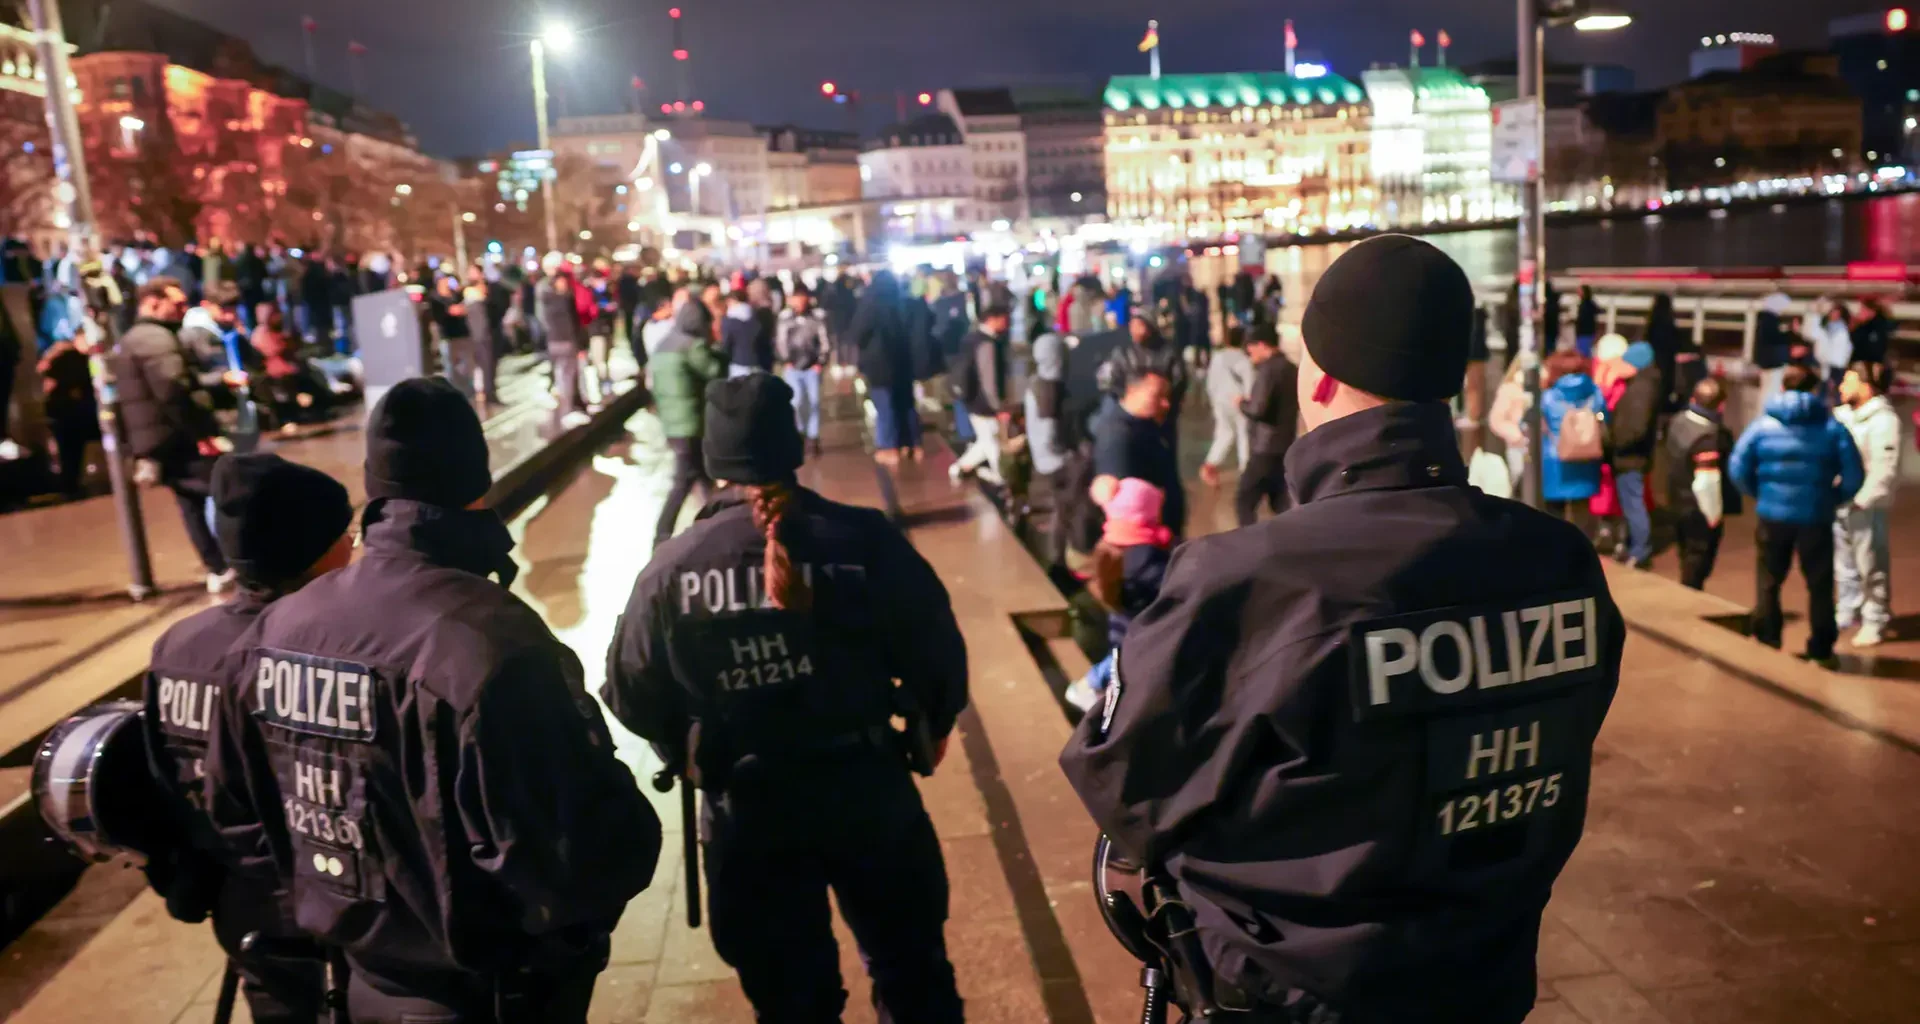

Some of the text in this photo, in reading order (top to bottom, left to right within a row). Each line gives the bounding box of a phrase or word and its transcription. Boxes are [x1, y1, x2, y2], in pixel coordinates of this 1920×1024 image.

[716, 654, 815, 692] 121214
[729, 633, 789, 664] HH
[1364, 597, 1597, 706] POLIZEI
[158, 676, 221, 732] POLI
[256, 657, 373, 732] POLIZEI
[1465, 720, 1541, 780] HH
[295, 761, 342, 807] HH
[1437, 772, 1564, 836] 121375
